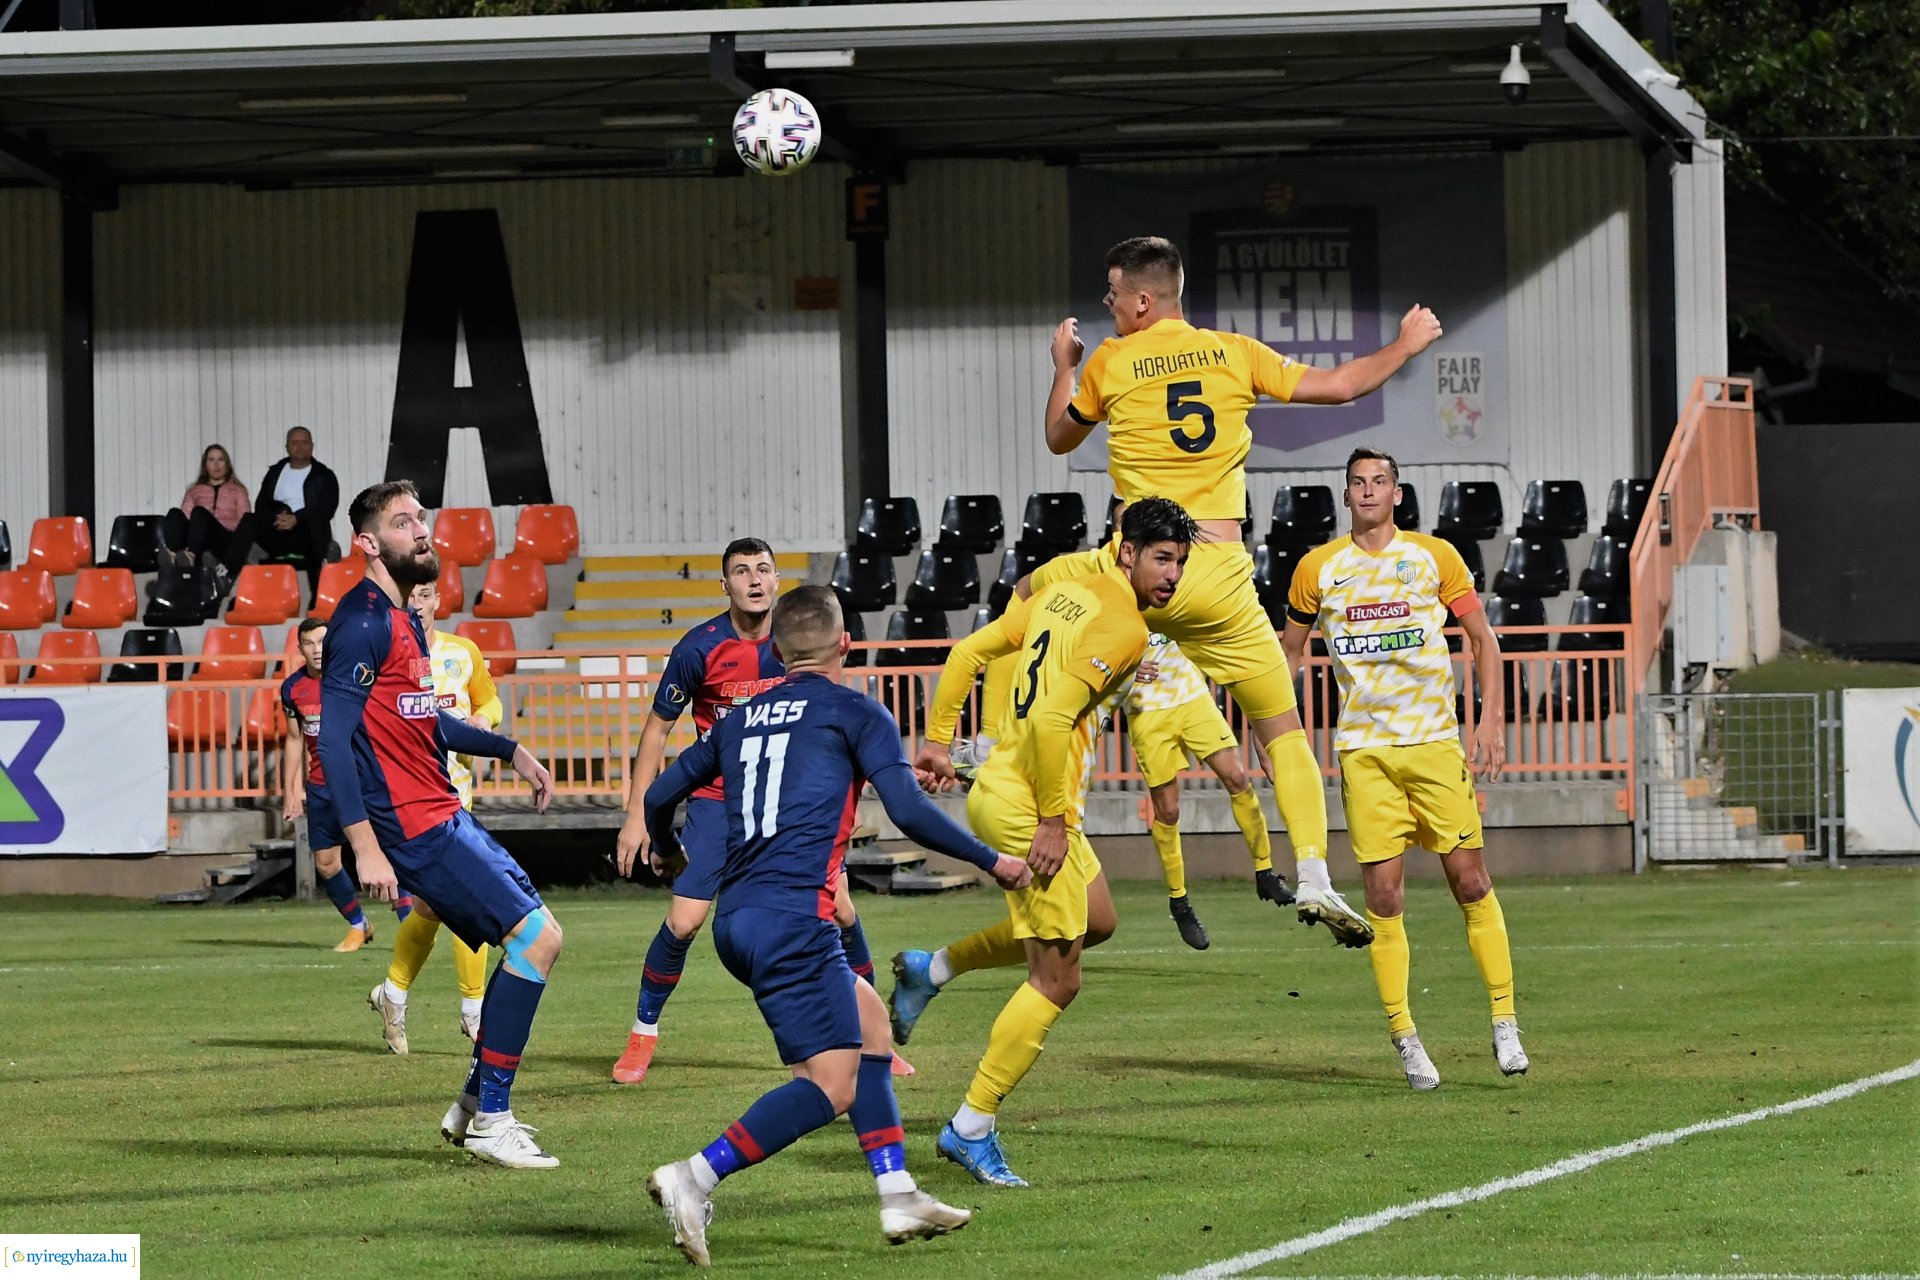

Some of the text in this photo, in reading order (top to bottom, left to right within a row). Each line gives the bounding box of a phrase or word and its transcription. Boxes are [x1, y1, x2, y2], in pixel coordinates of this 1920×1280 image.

[854, 184, 881, 221] F
[1216, 243, 1232, 270] A
[1216, 270, 1355, 342] NEM
[384, 208, 554, 509] A
[1212, 349, 1231, 368] M.
[1438, 357, 1480, 375] FAIR
[1438, 377, 1481, 394] PLAY
[1166, 380, 1216, 453] 5
[678, 562, 690, 579] 4
[661, 608, 673, 625] 3
[1014, 629, 1051, 719] 3
[744, 699, 808, 729] VASS
[739, 732, 791, 841] 11
